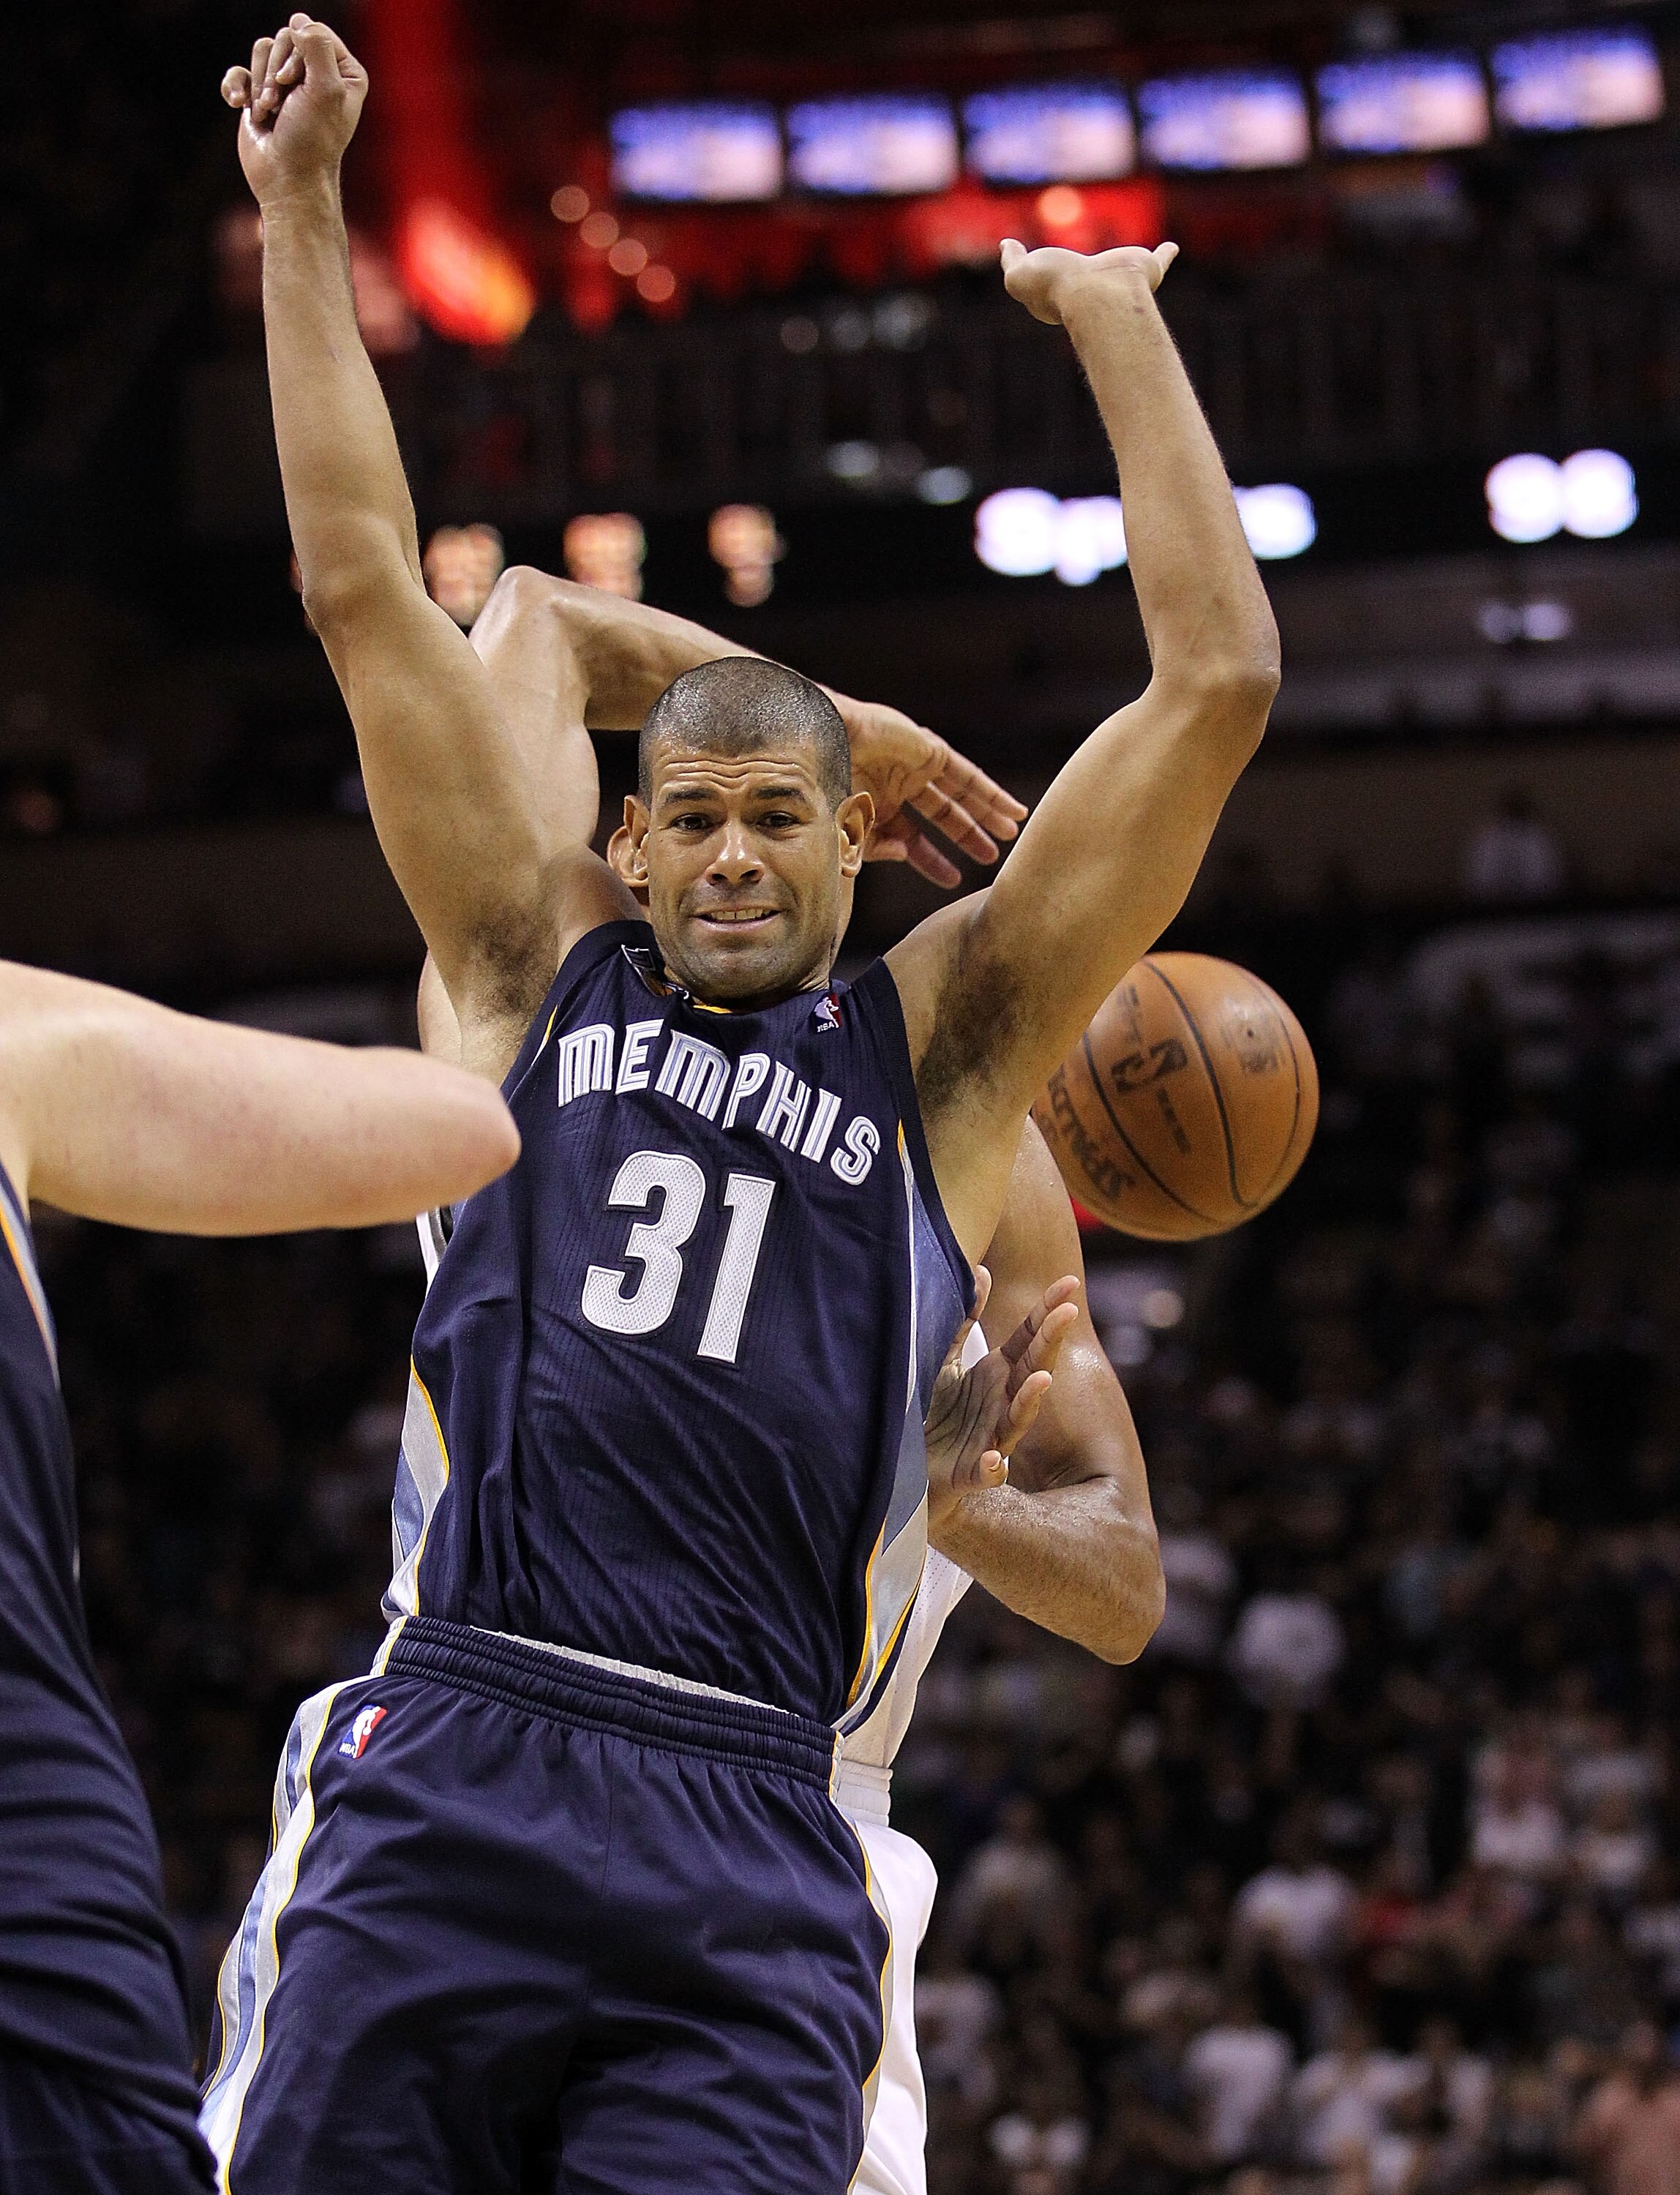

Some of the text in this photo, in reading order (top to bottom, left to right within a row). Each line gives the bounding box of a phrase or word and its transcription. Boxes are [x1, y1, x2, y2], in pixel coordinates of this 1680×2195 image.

[817, 1021, 835, 1032] NBA
[558, 1018, 881, 1186] MEMPHIS
[581, 1149, 776, 1364] 31
[339, 1742, 355, 1755] NBA
